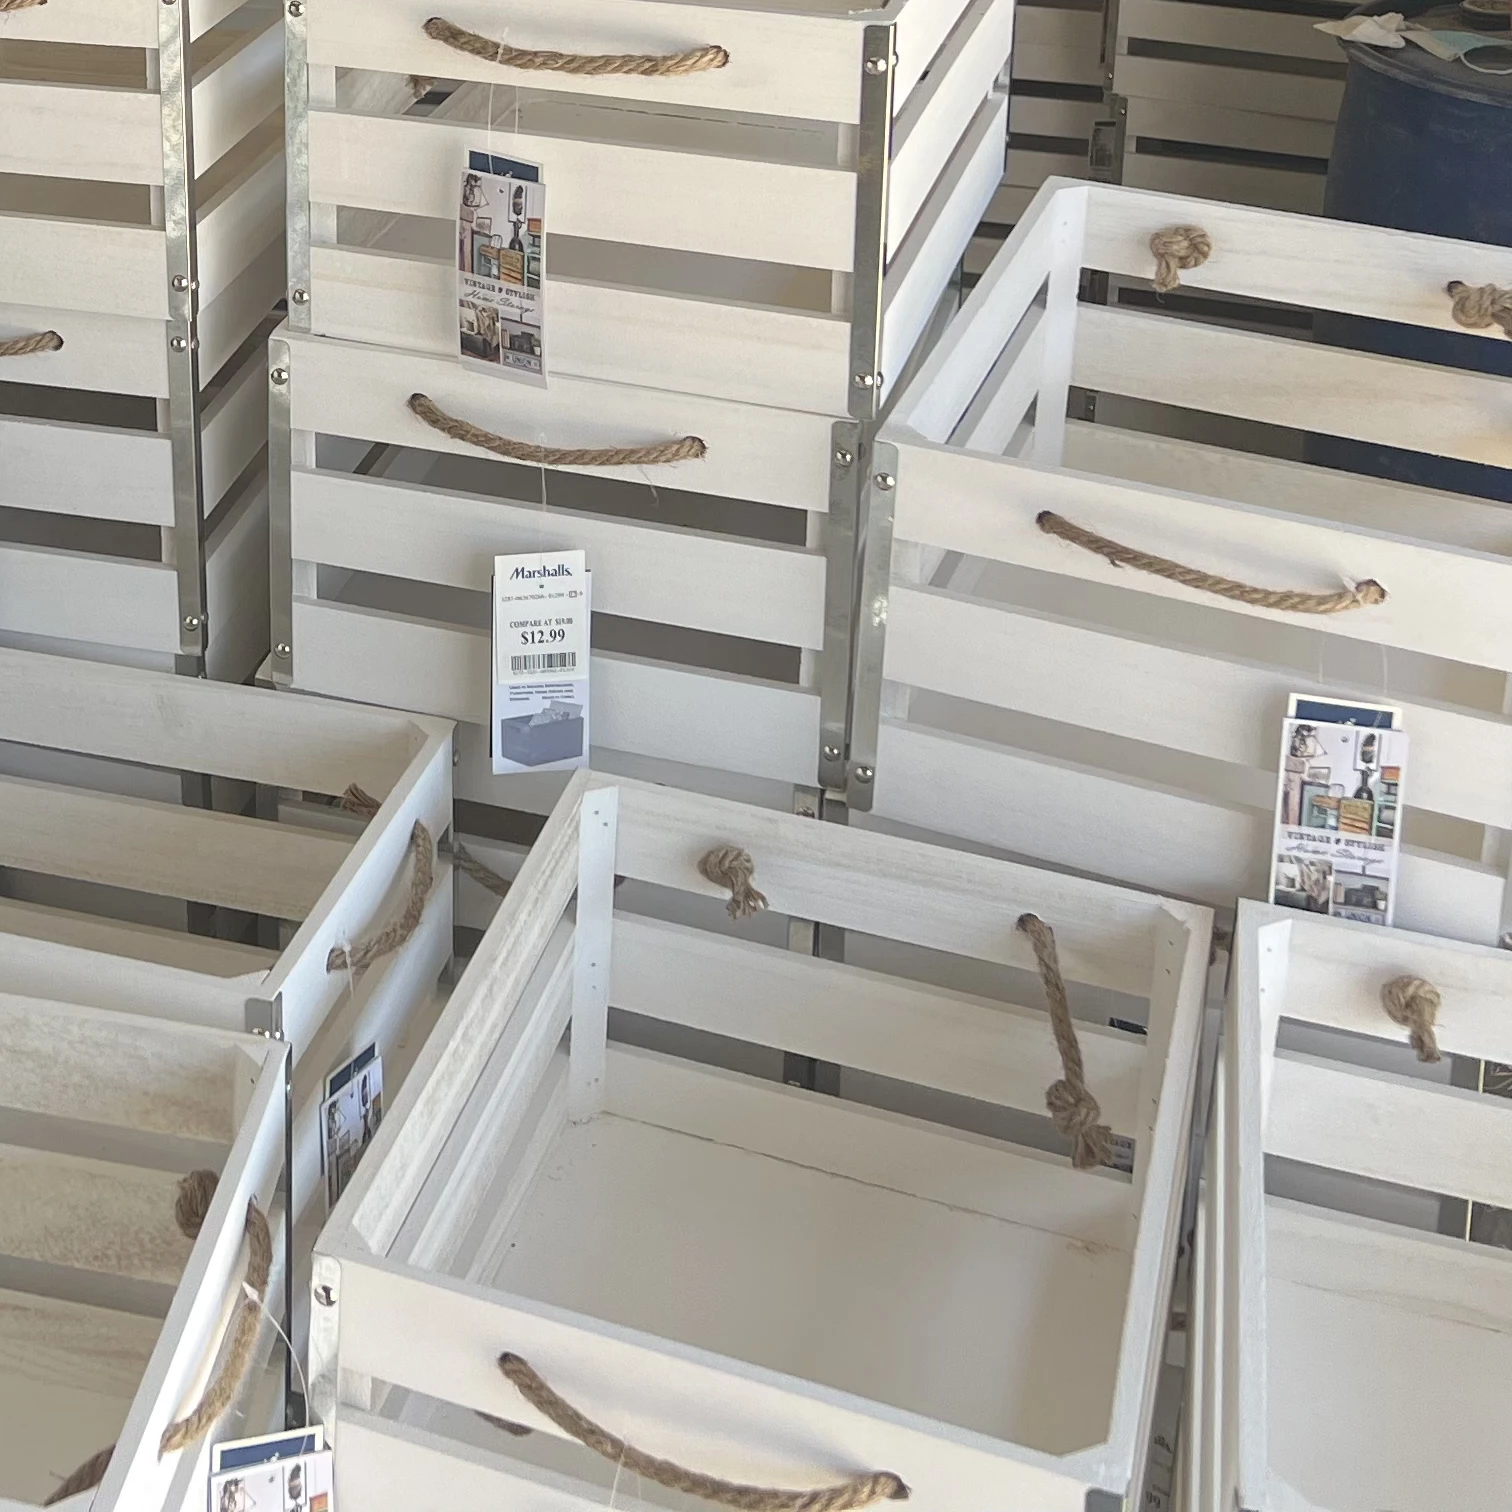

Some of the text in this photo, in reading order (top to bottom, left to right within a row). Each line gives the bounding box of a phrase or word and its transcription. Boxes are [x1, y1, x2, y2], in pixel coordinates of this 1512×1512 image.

[509, 564, 573, 580] Marshalls
[509, 619, 542, 628] COMPARE
[544, 618, 553, 626] AT
[520, 628, 565, 645] $12.99
